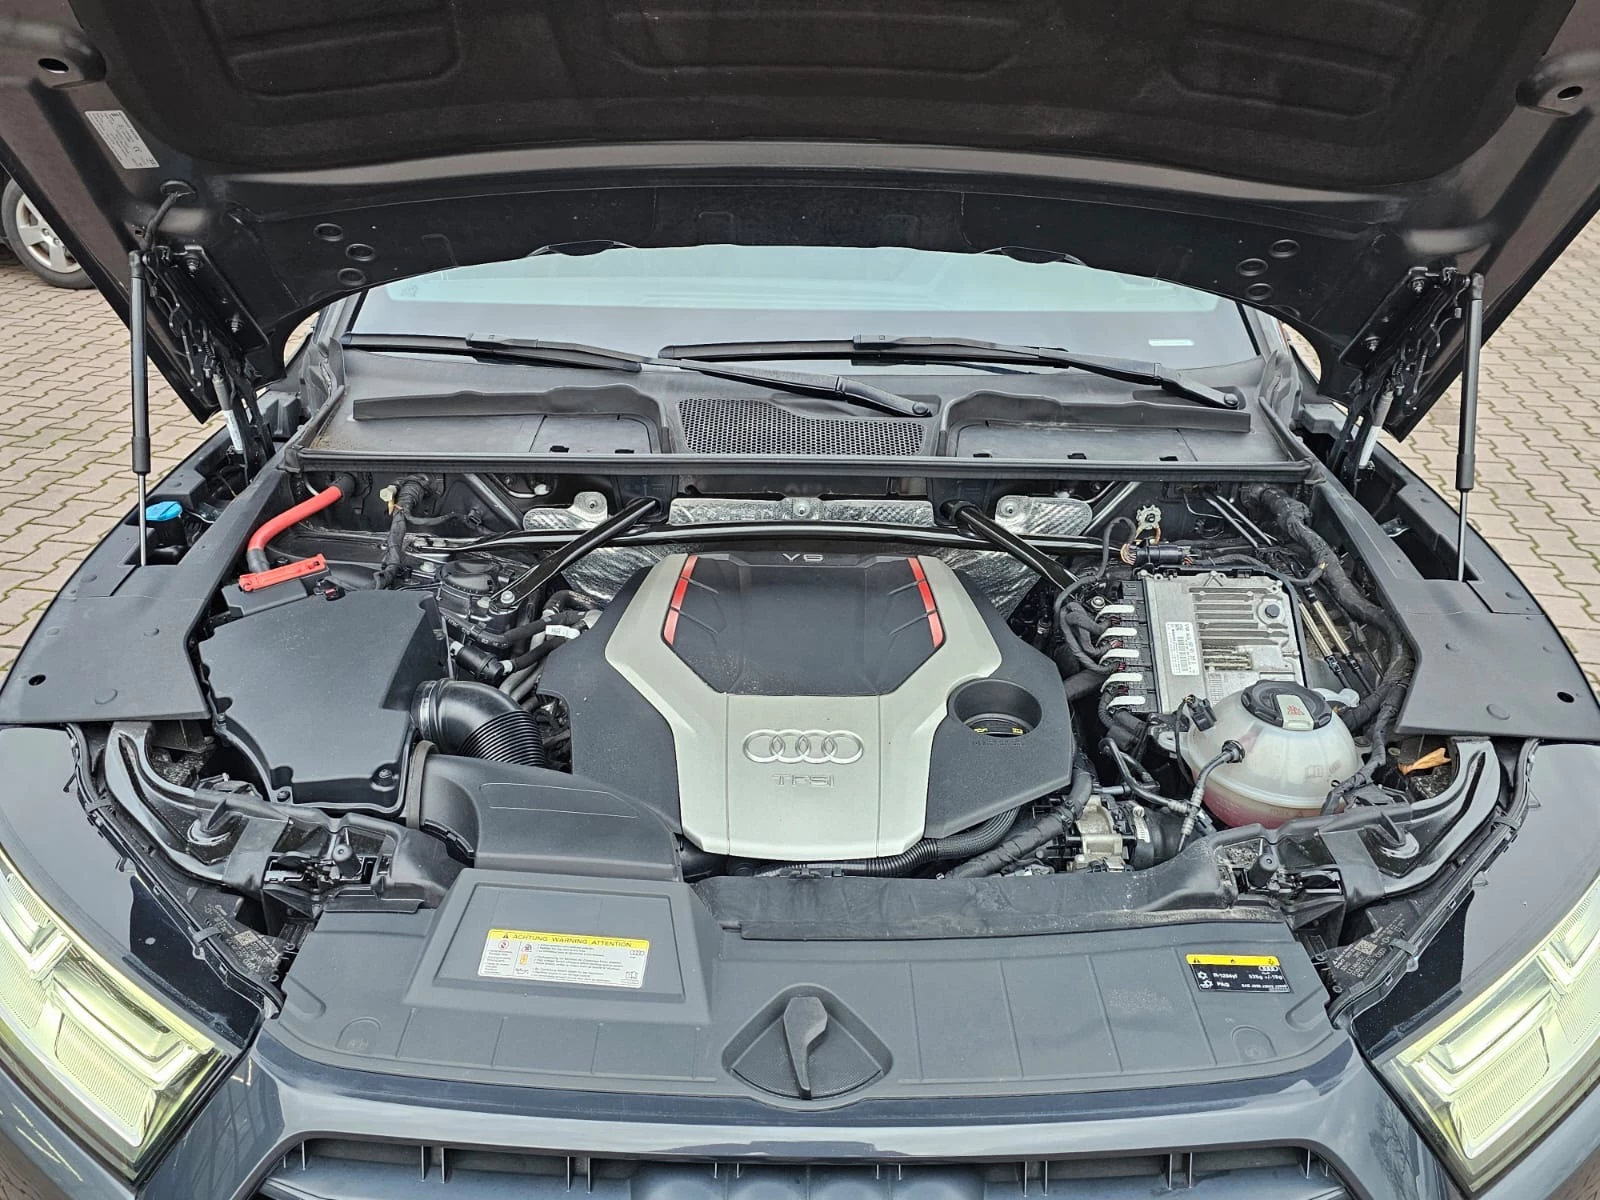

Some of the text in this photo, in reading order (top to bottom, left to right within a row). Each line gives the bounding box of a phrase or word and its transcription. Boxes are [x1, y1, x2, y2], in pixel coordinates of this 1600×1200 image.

[782, 553, 823, 562] V6
[513, 934, 632, 948] ACHTUNG WARNING ATTENTION
